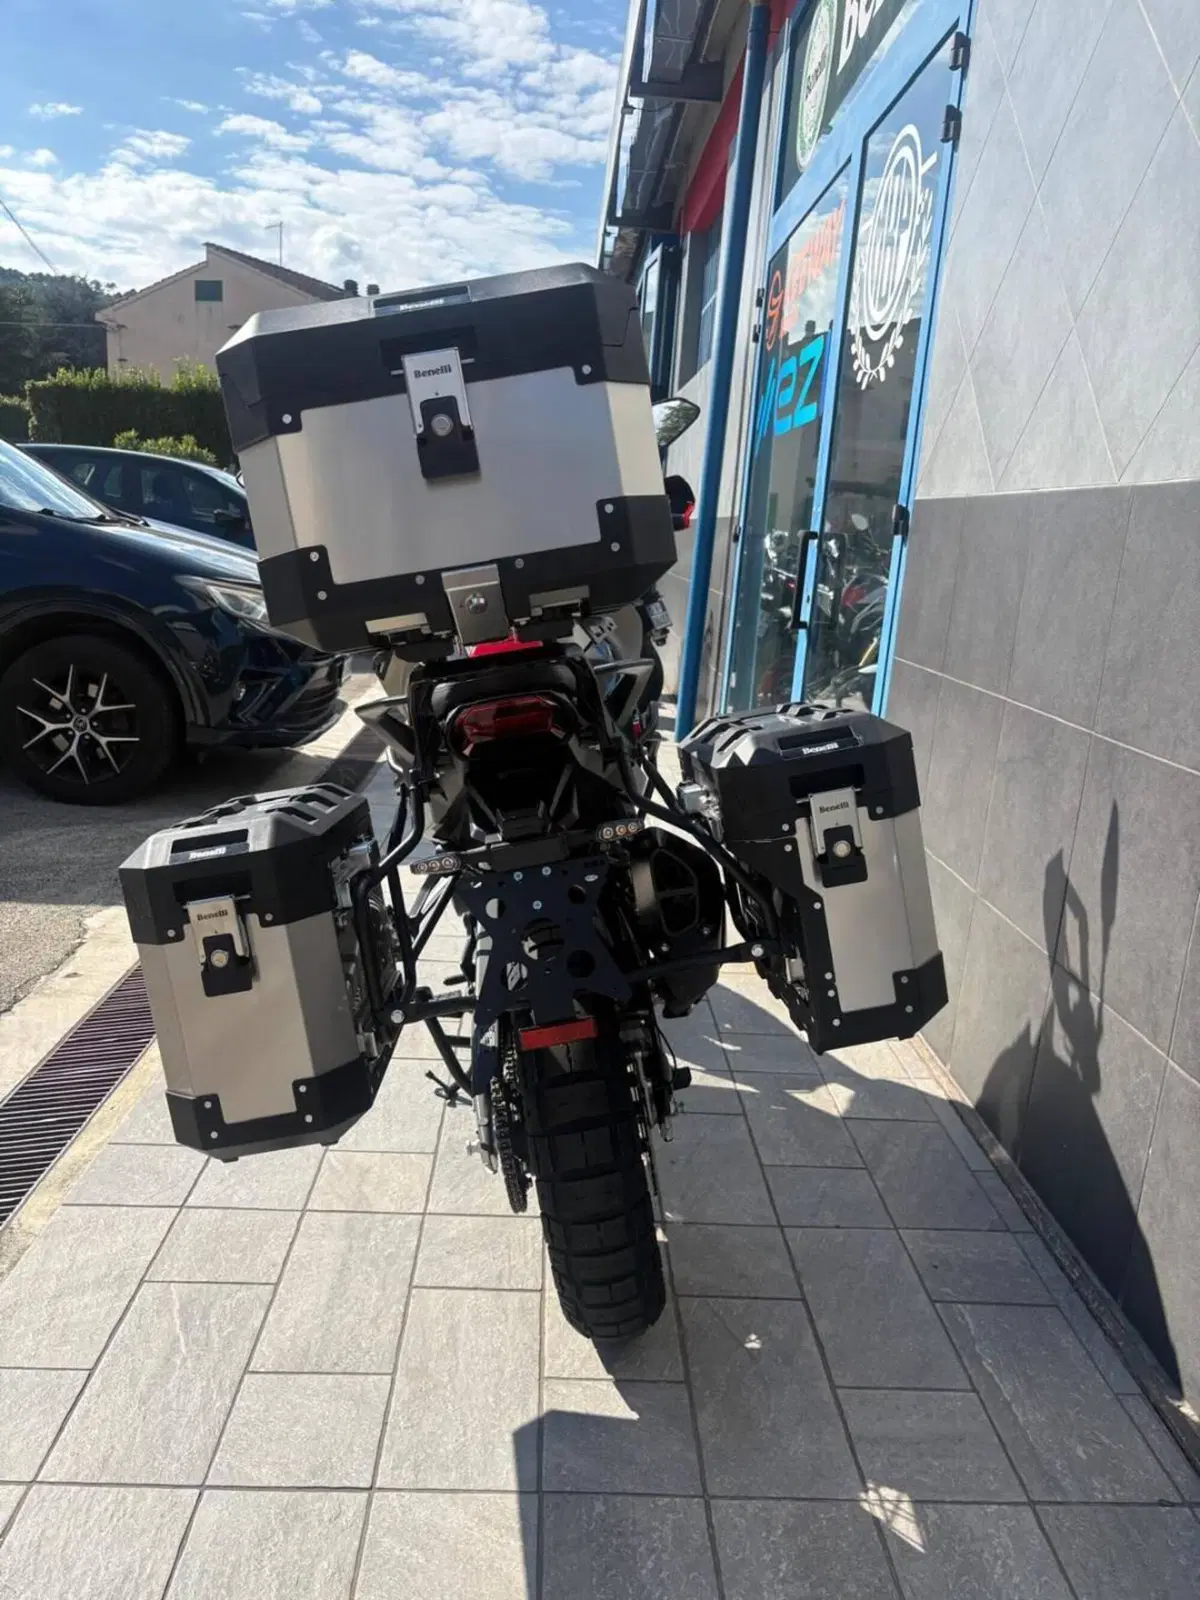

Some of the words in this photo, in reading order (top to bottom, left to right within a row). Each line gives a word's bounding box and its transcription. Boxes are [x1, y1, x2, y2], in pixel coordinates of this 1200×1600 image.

[413, 363, 452, 378] Benelli
[802, 742, 839, 755] Benelli
[819, 801, 849, 813] Benelli
[196, 909, 228, 921] Benelli
